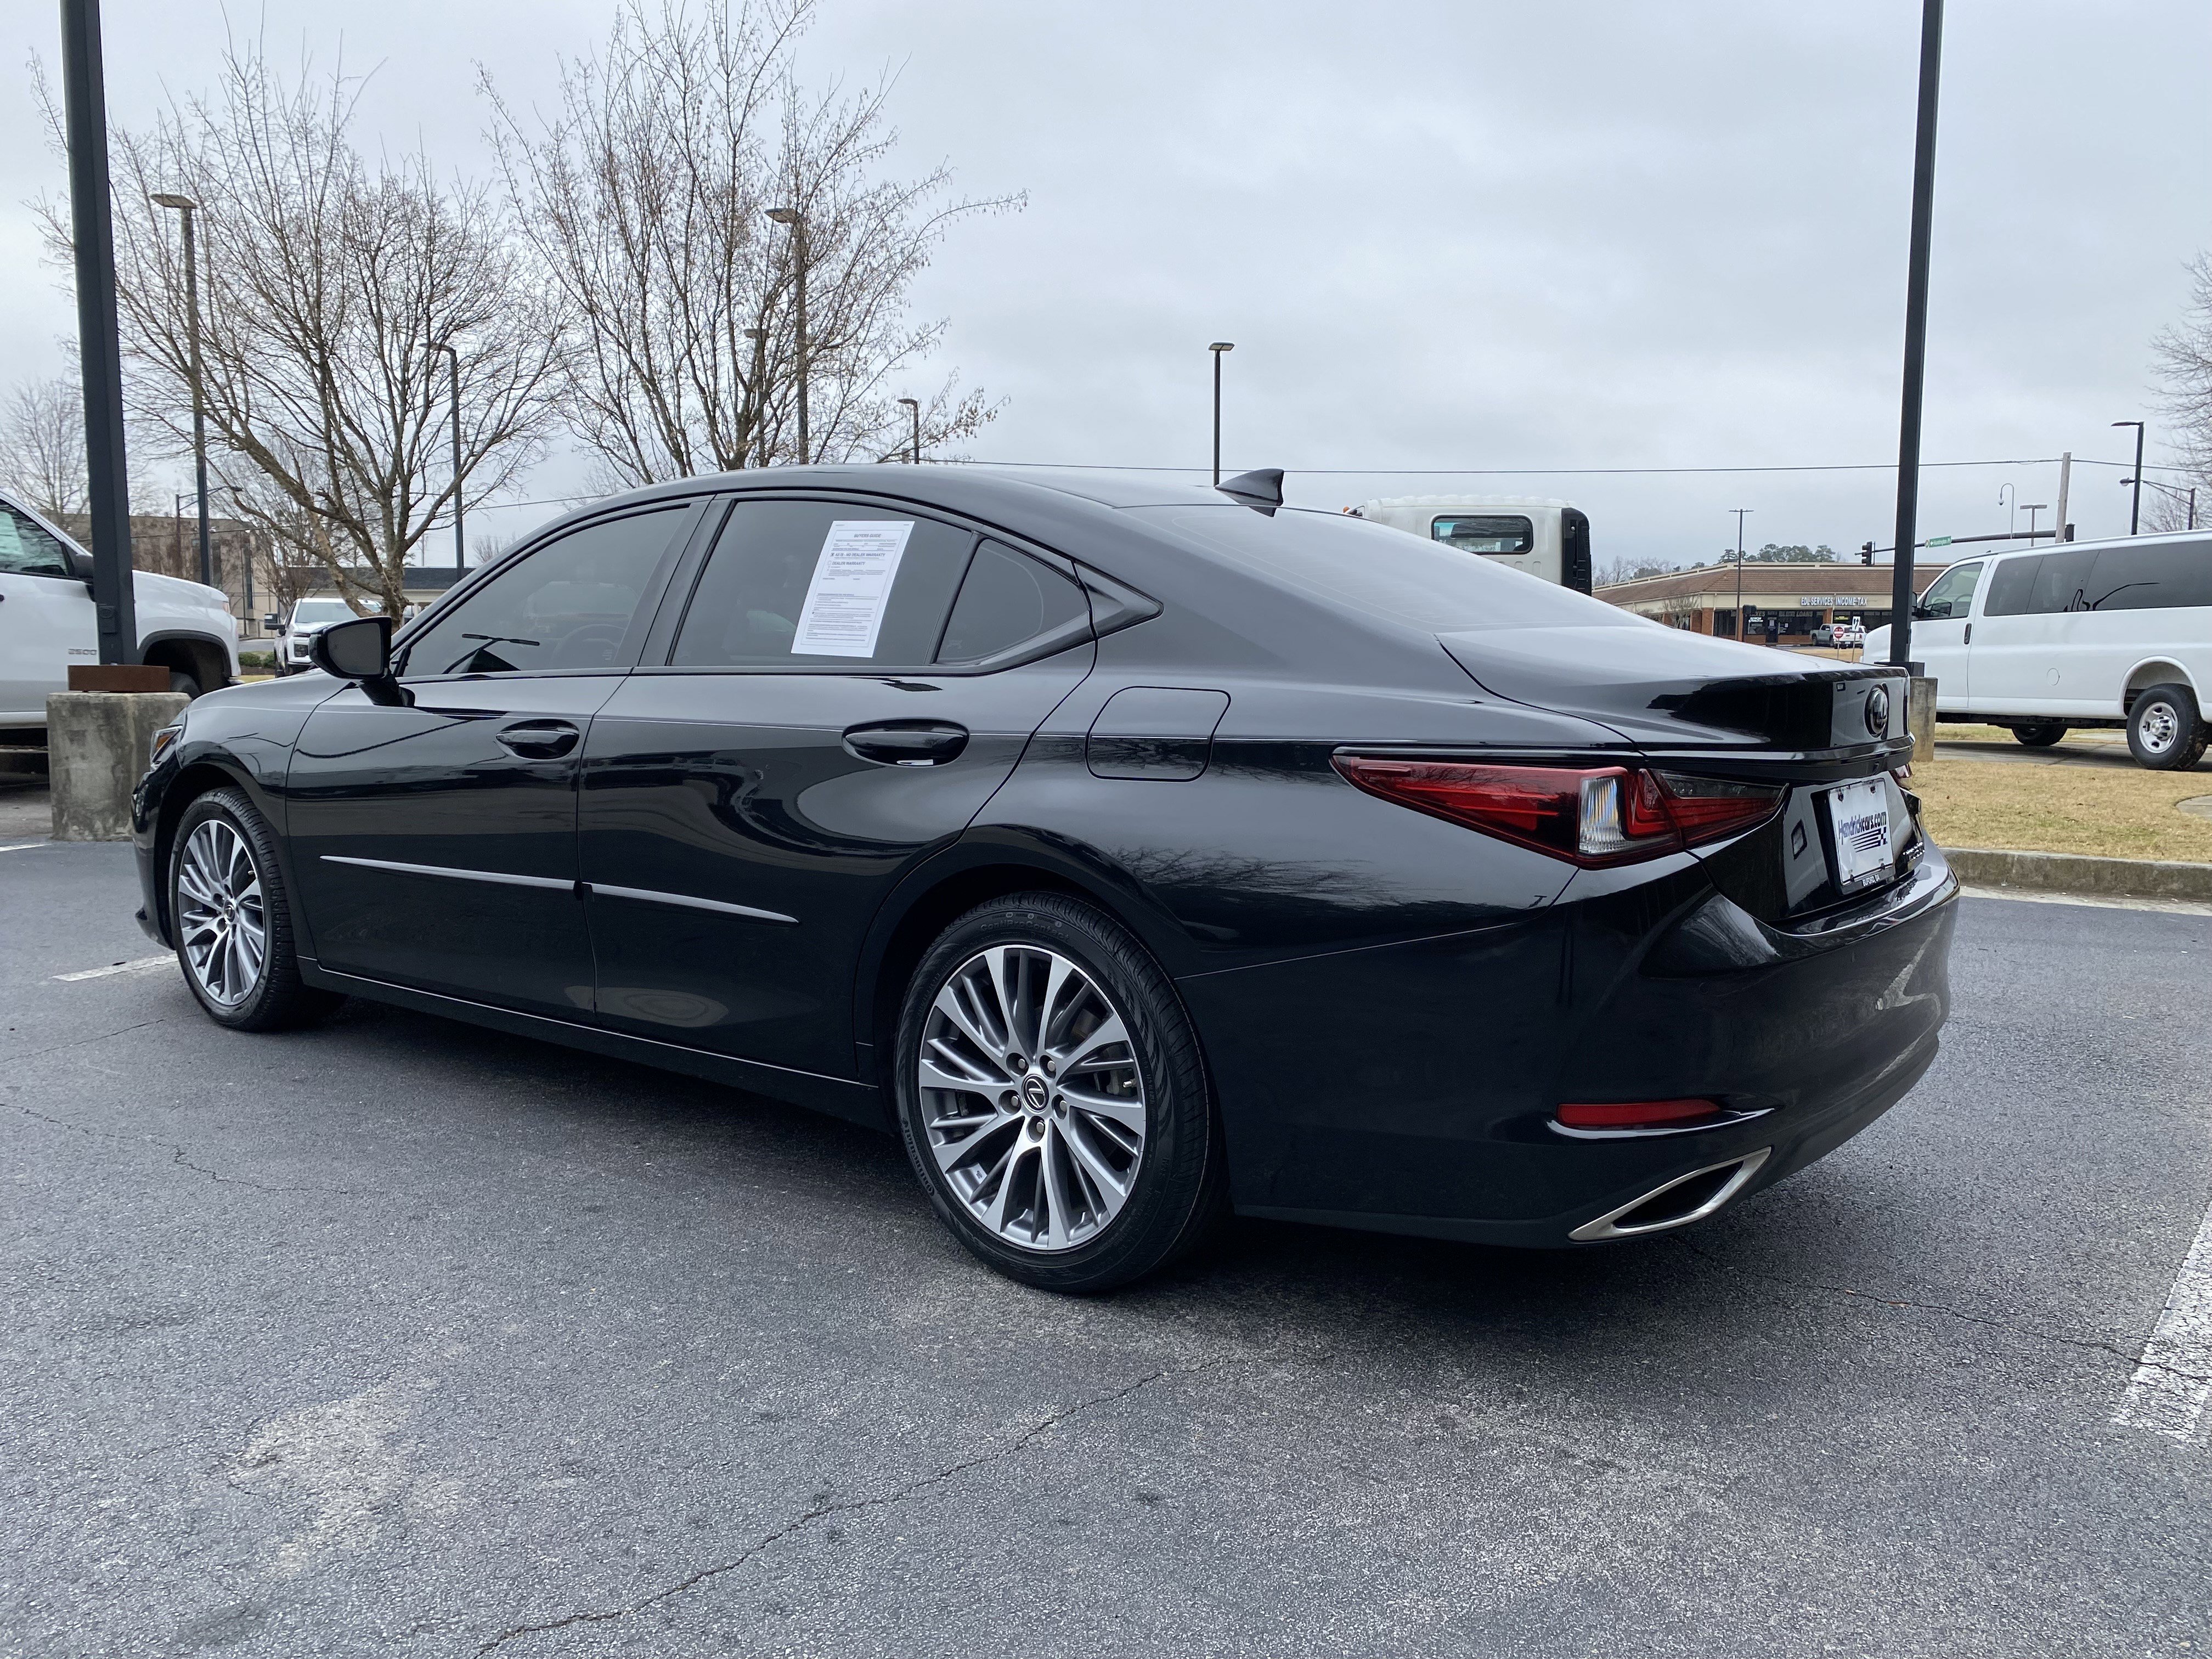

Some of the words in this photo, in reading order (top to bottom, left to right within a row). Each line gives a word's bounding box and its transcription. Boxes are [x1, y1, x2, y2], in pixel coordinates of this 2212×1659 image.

[1810, 596, 1833, 606] SERVICES
[1835, 596, 1857, 606] INCOME
[1857, 596, 1868, 606] TAX
[980, 919, 1069, 941] ContiProContact
